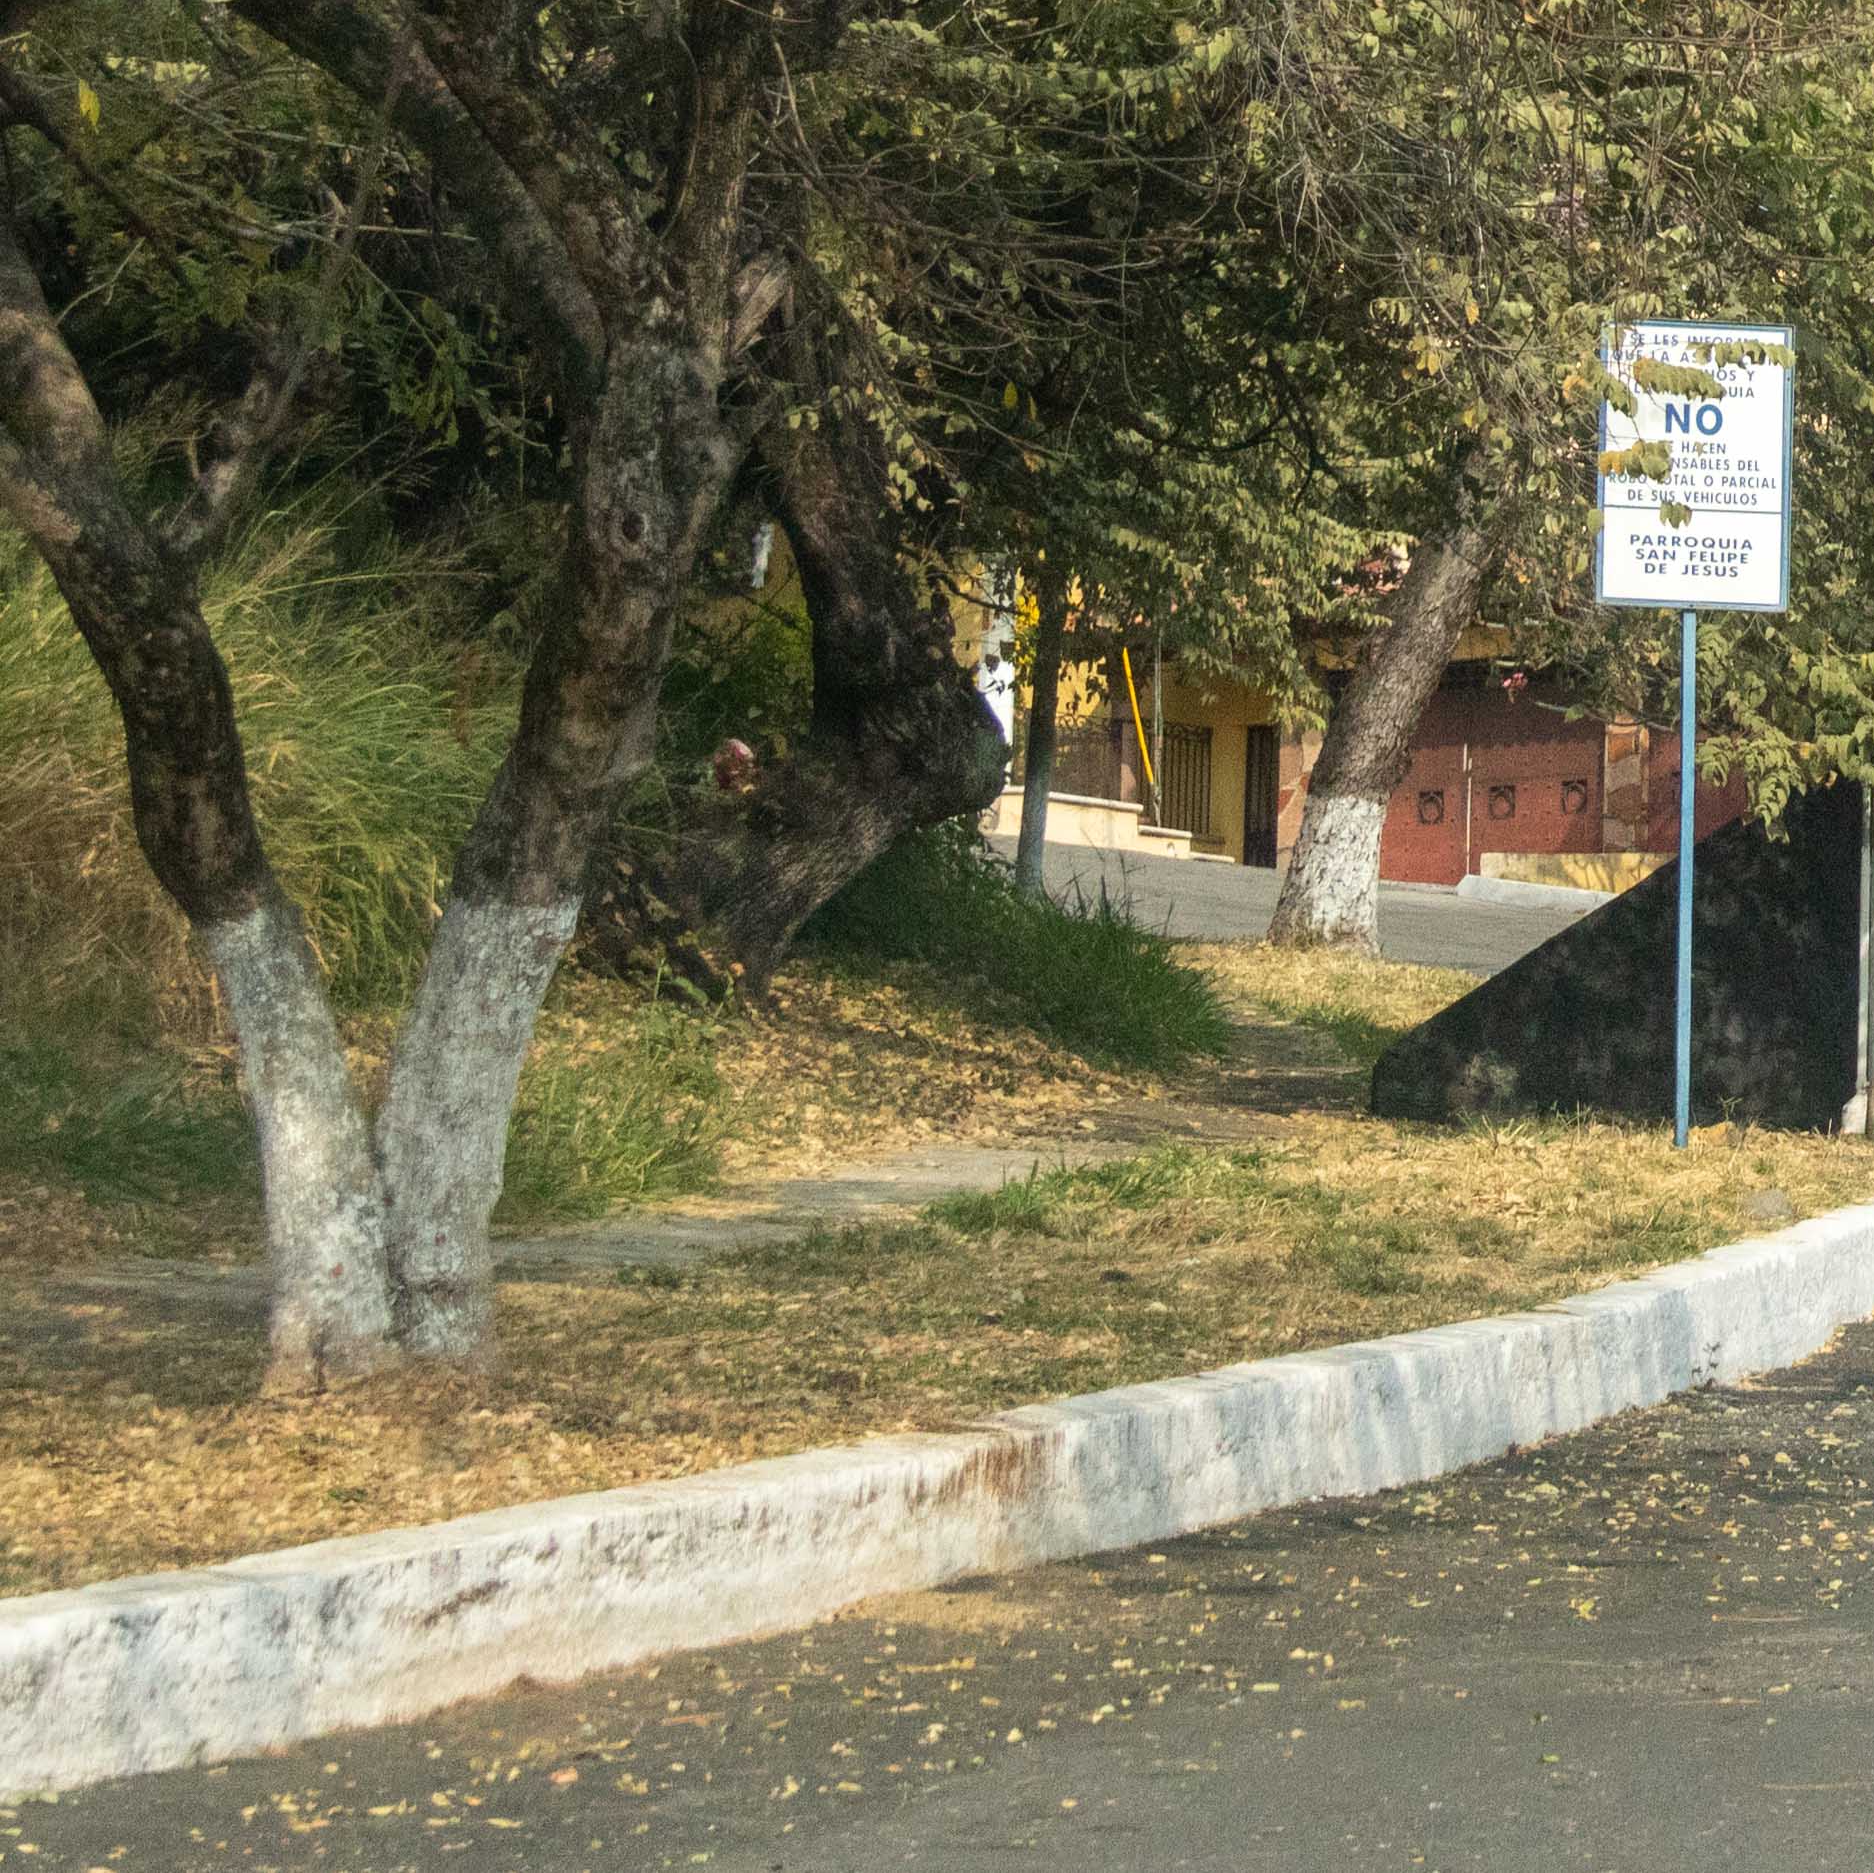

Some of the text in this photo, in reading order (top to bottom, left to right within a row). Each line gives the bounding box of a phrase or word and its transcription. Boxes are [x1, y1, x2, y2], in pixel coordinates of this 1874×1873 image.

[1630, 333, 1645, 345] SE
[1654, 334, 1679, 346] LES
[1747, 370, 1755, 382] Y
[1665, 402, 1723, 436] NO
[1682, 441, 1726, 455] HACEN
[1738, 459, 1760, 472] DEL
[1659, 473, 1696, 486] OTAL
[1703, 475, 1714, 487] O
[1721, 476, 1776, 489] PARCIAL
[1627, 488, 1758, 506] DE SUS VEHICULOS
[1630, 533, 1753, 551] PARROQUIA
[1635, 548, 1749, 564] SAN FELIPE
[1644, 562, 1739, 578] DE JESUS
